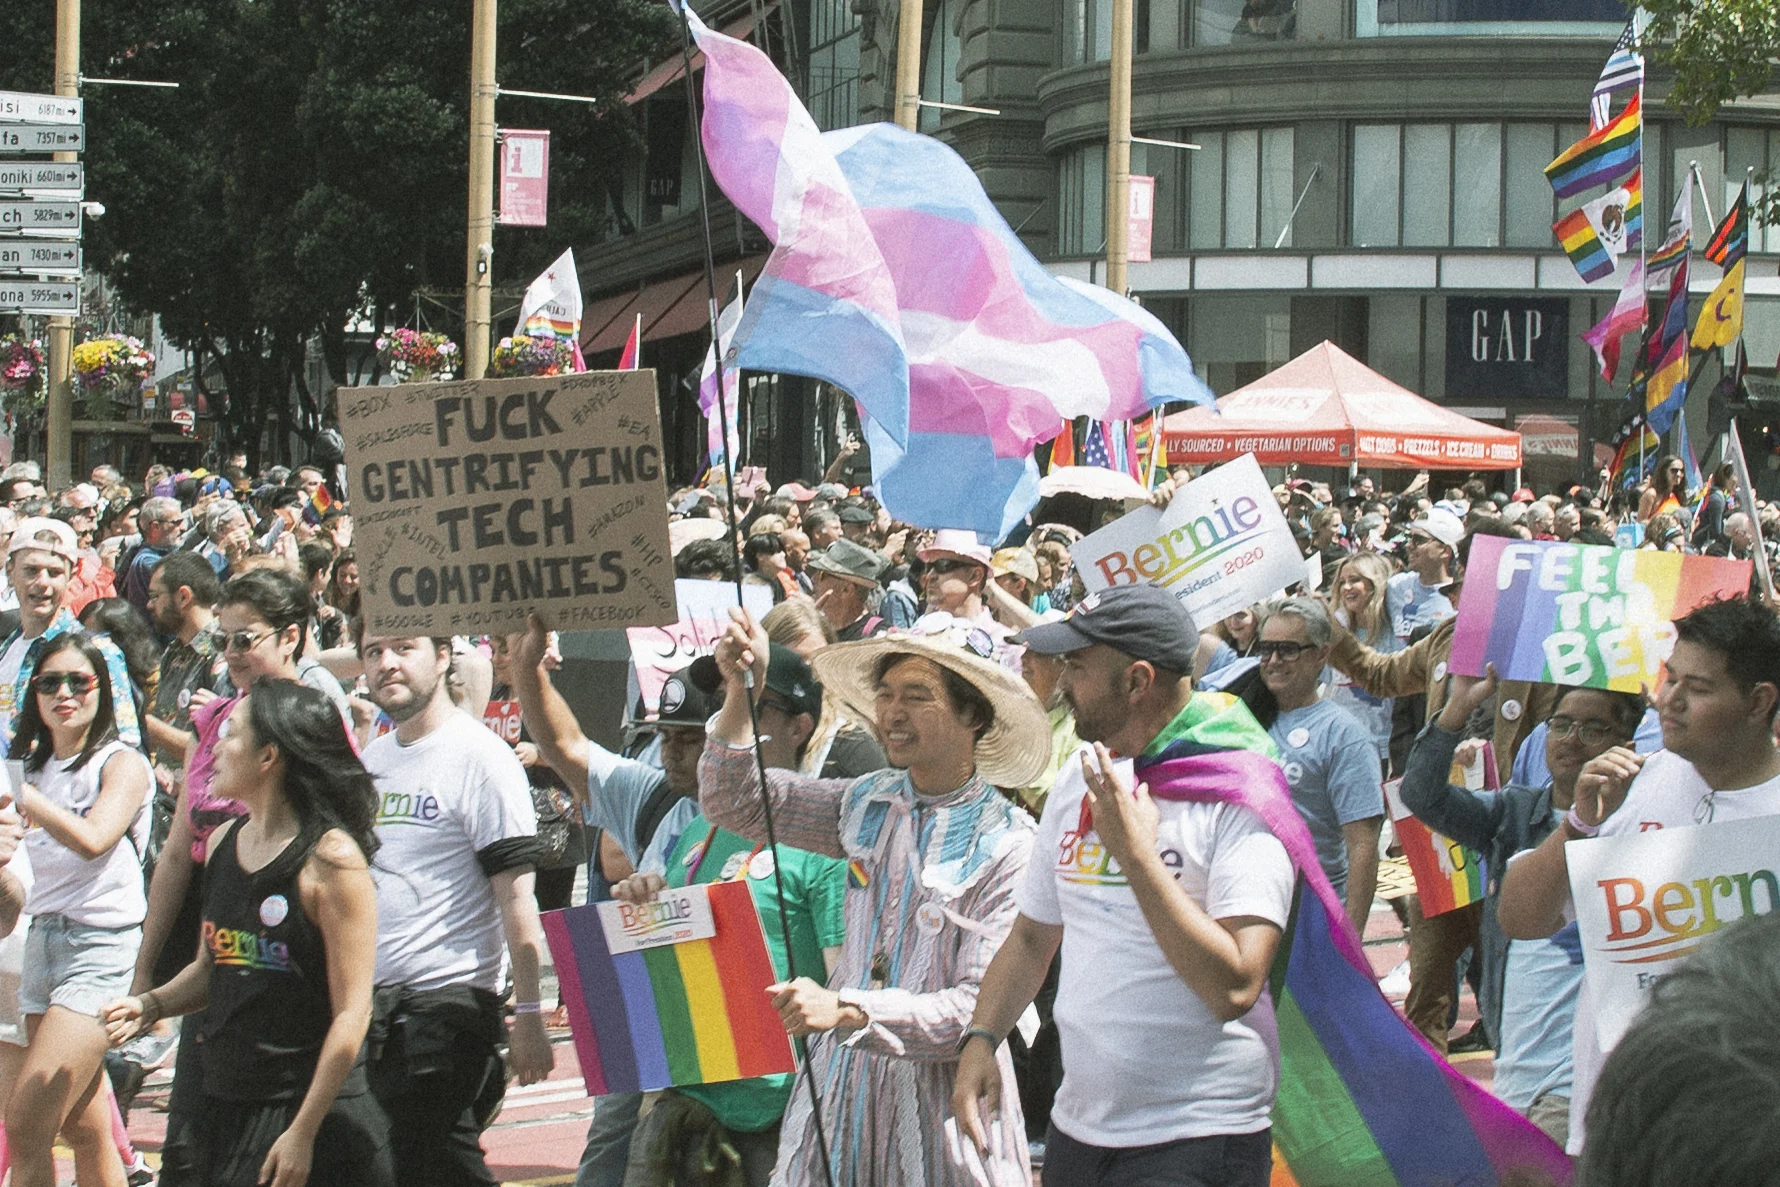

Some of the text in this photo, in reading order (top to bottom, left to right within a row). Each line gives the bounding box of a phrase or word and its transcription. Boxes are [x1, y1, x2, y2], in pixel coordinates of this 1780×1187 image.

[1472, 309, 1541, 362] GAP
[346, 391, 393, 418] #BOX
[434, 389, 565, 447] FUCK
[1181, 438, 1224, 453] SOURCED
[1234, 437, 1292, 452] VEGETARIAN
[1293, 436, 1336, 452] OPTIONS
[1404, 438, 1440, 456] PRETZELS
[361, 445, 659, 503] GENTRIFYING
[436, 497, 576, 552] TECH
[1095, 496, 1262, 586] Bernie
[389, 551, 629, 609] COMPANIES
[1224, 547, 1264, 575] 2020
[1496, 543, 1652, 594] FEEL
[558, 605, 647, 622] #FACEBOOK
[617, 895, 693, 929] Bernie
[1597, 869, 1780, 943] Bern
[202, 921, 289, 967] Bernie
